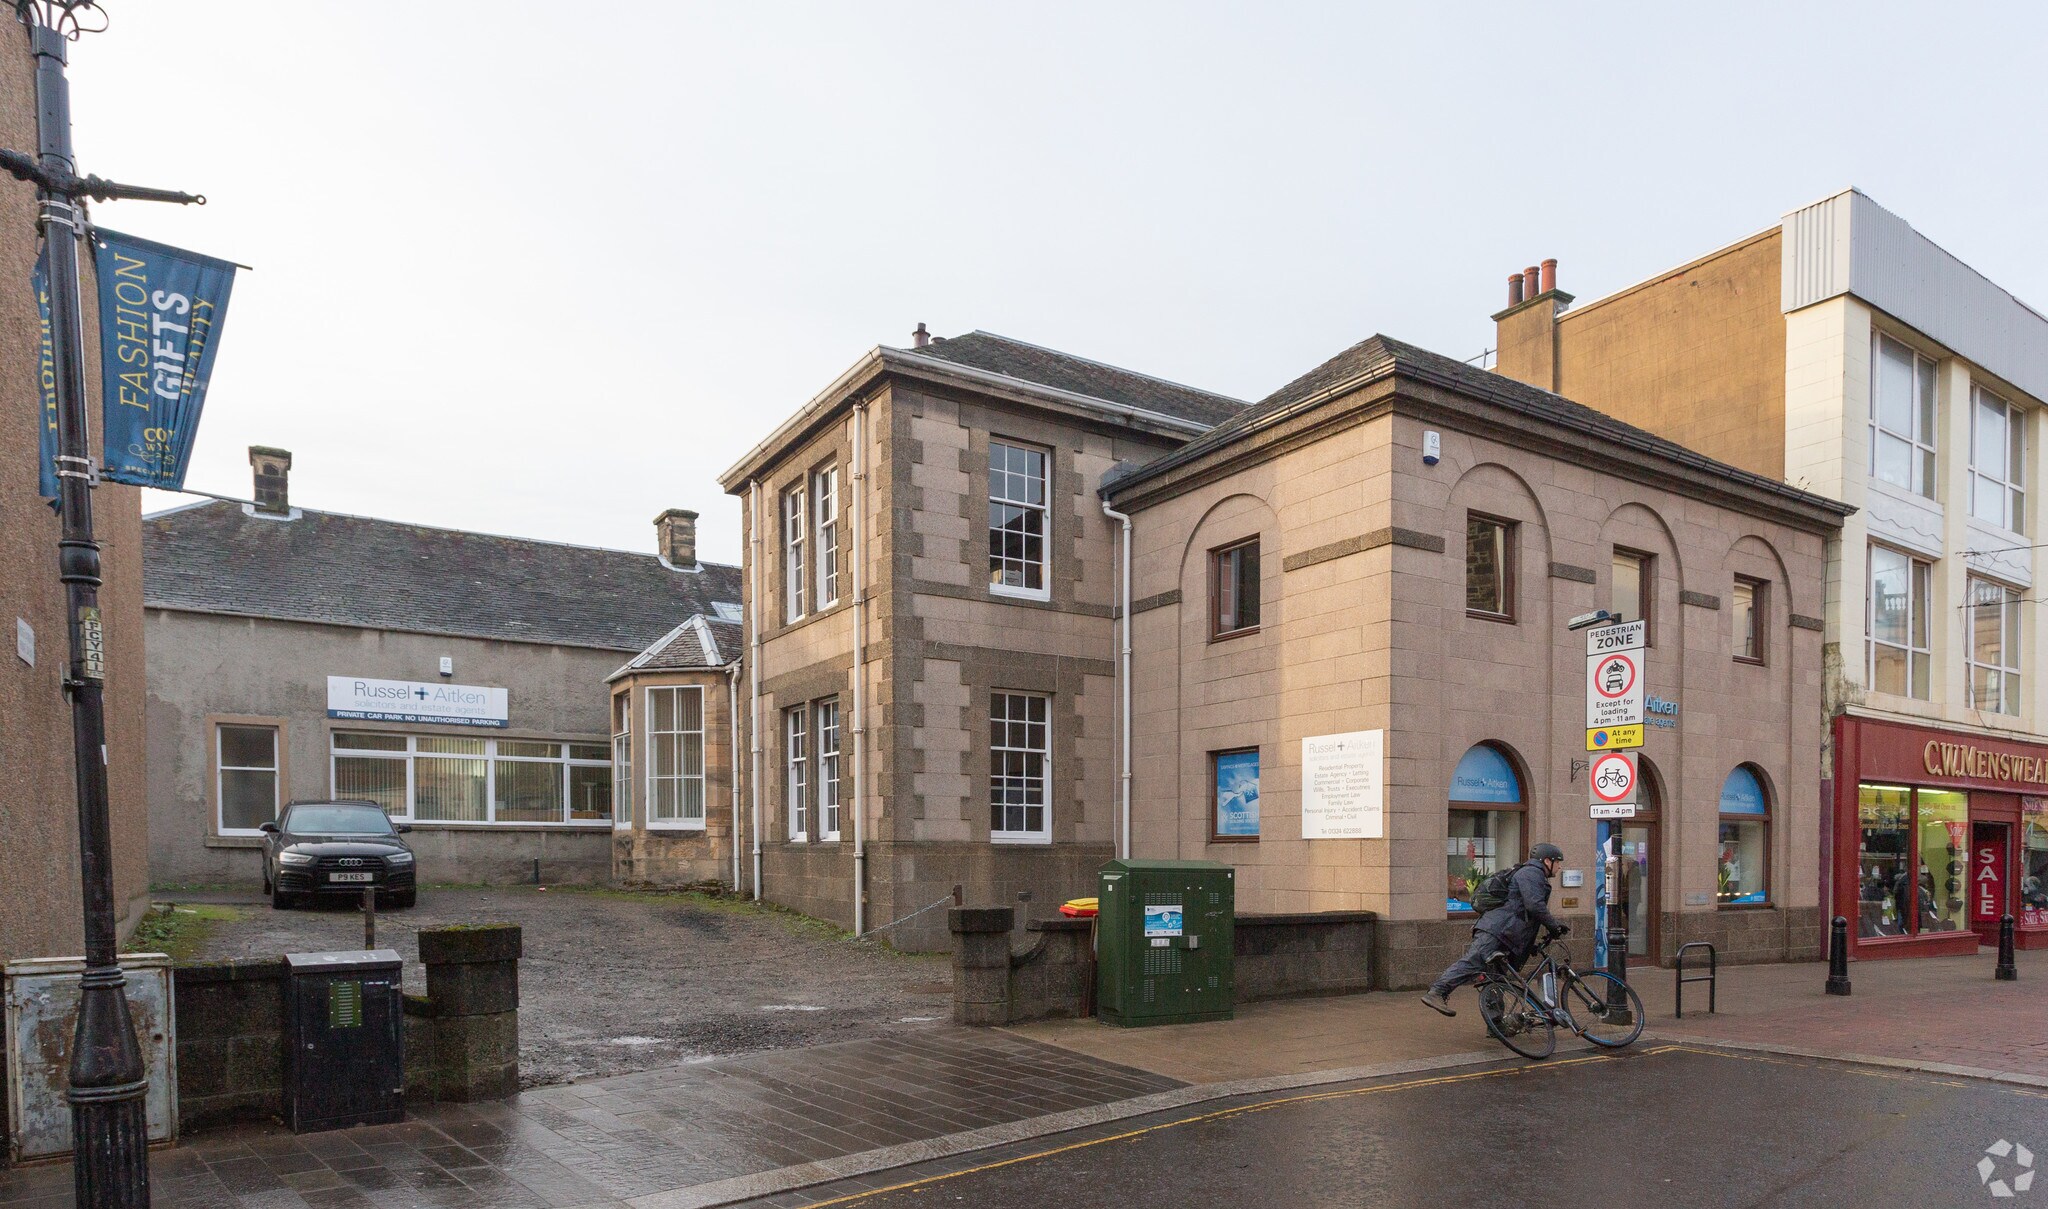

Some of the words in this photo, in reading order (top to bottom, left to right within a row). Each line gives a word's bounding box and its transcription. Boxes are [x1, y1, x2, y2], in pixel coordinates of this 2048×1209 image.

[114, 252, 150, 412] FASHION
[151, 290, 190, 400] GIFTS
[1590, 623, 1642, 638] PEDESTRIAN
[1597, 633, 1634, 649] ZONE
[354, 681, 410, 700] Russel
[433, 687, 486, 705] Aitken
[354, 699, 396, 709] solicitors
[400, 702, 418, 711] and
[421, 703, 451, 713] estate
[454, 705, 486, 715] agents
[1595, 700, 1621, 709] Except
[1601, 707, 1628, 716] loading
[1644, 694, 1679, 715] Aitken
[336, 710, 365, 719] PRIVATE
[417, 715, 470, 724] UNAUTHORISED
[471, 718, 500, 726] PARKING
[1612, 729, 1621, 737] At
[1308, 741, 1336, 754] Russel
[1346, 739, 1376, 751] Aitken
[1615, 737, 1632, 745] time
[1329, 771, 1347, 779] Agency
[1457, 776, 1480, 787] Russel
[1487, 778, 1508, 788] Aitken
[1976, 848, 1998, 915] SALE
